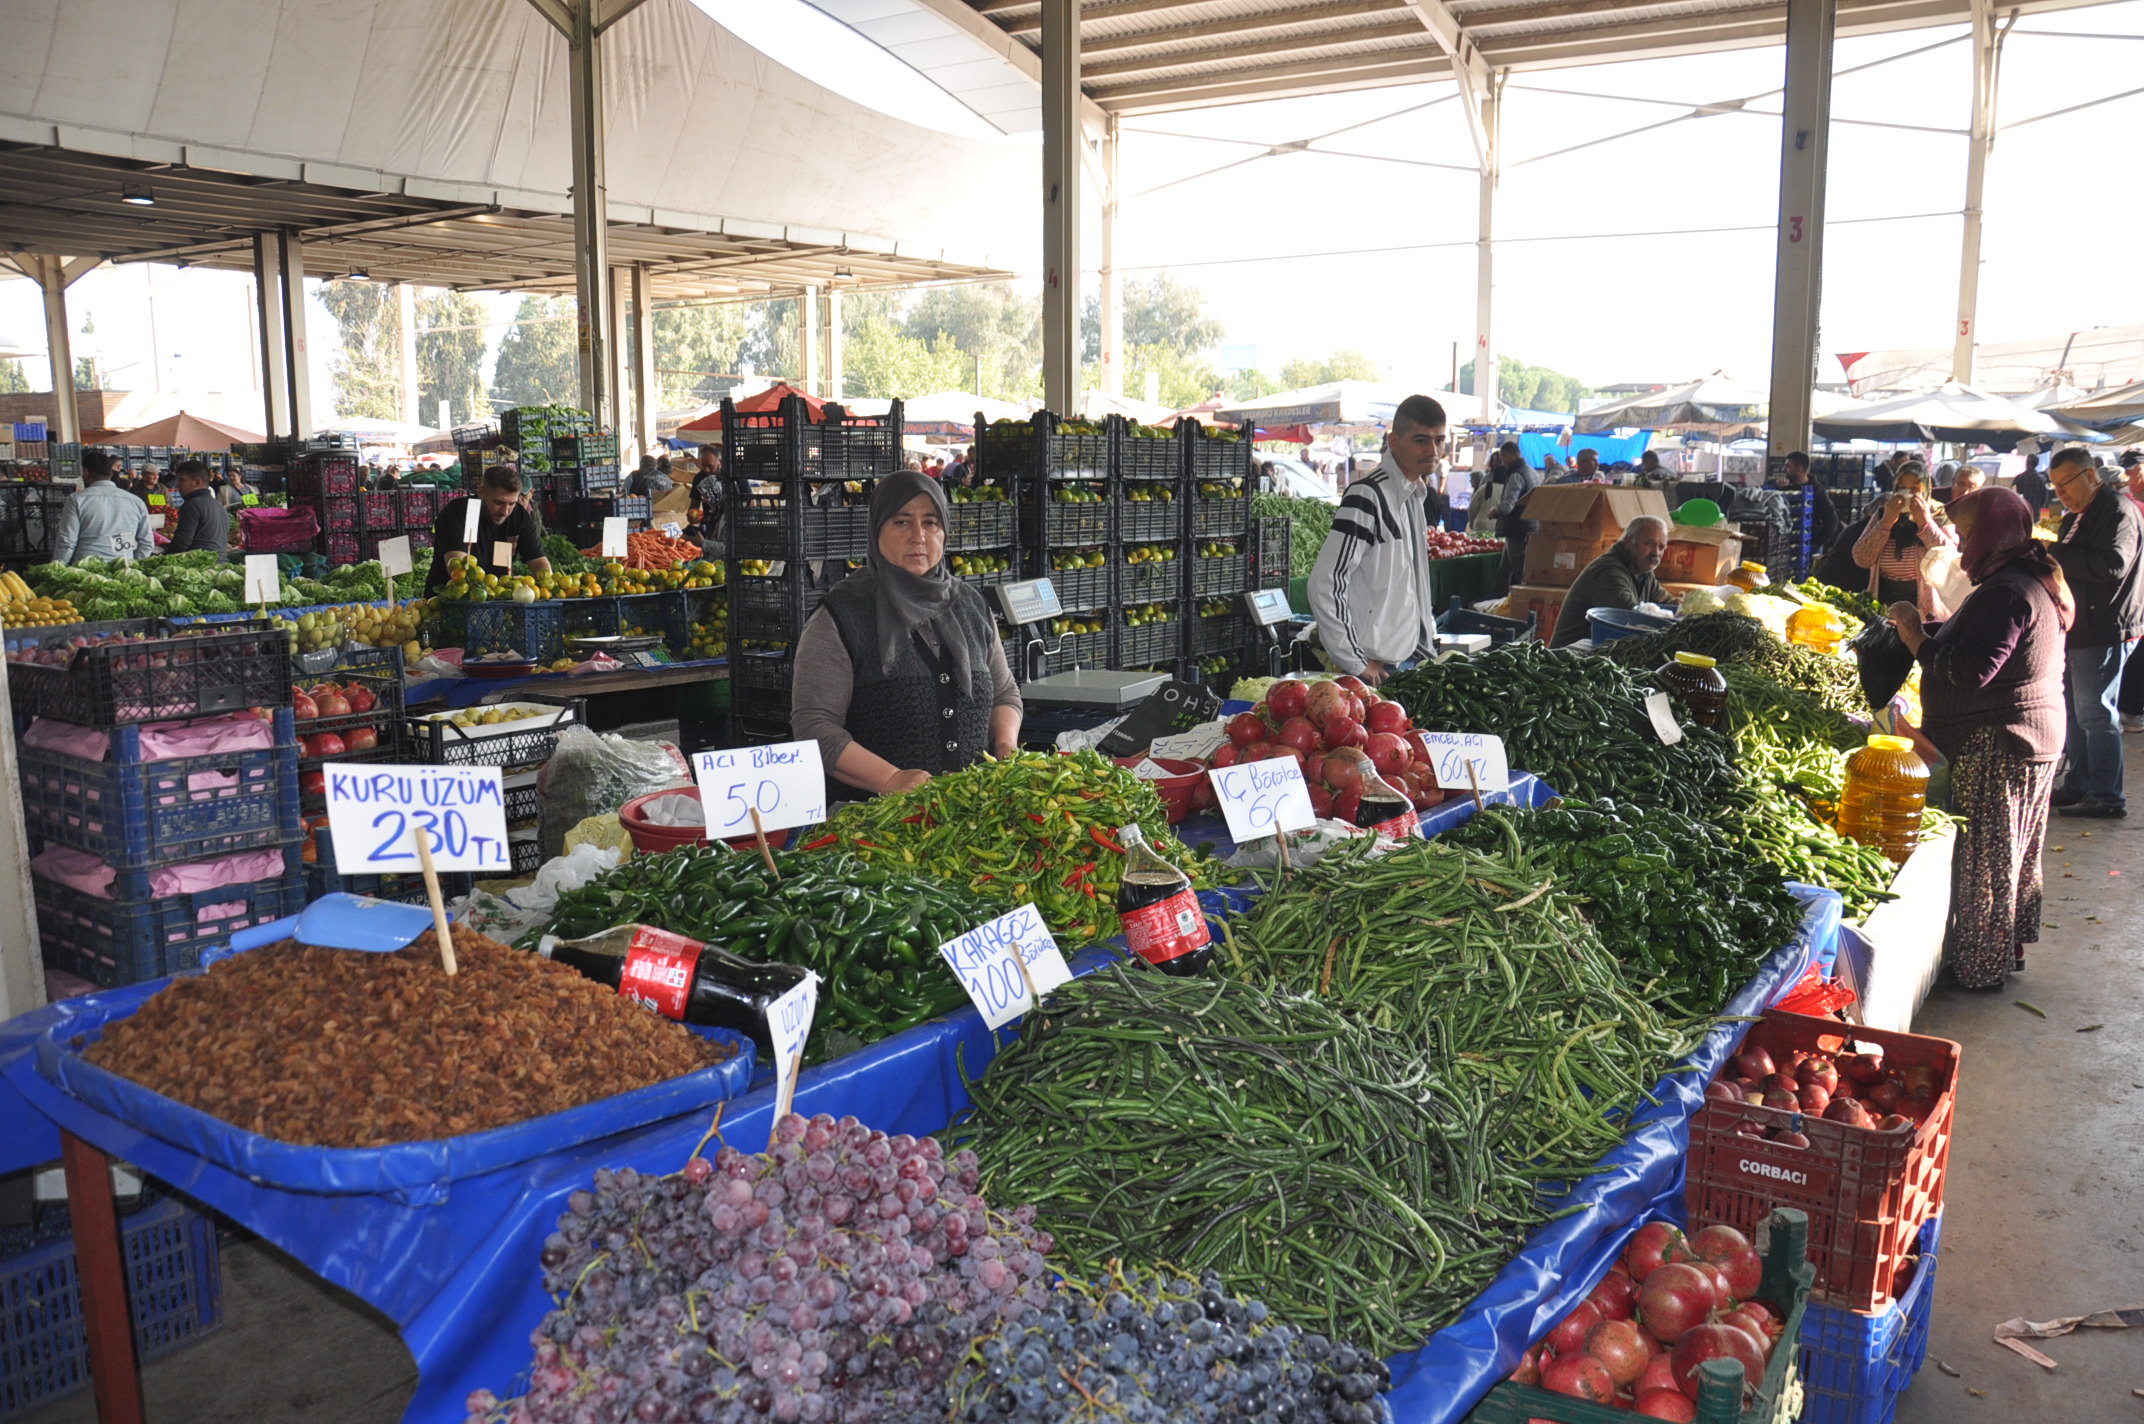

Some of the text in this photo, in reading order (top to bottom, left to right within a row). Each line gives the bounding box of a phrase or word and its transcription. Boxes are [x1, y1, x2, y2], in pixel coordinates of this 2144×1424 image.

[1789, 215, 1803, 243] 3
[1960, 320, 1969, 336] 3
[703, 754, 735, 770] ACI
[332, 769, 502, 806] KURU ÜZÜM
[367, 809, 507, 866] 230 TL
[943, 910, 1037, 982] KARAGÖZ
[971, 957, 1024, 1017] 100
[780, 988, 809, 1034] ÜZÜM
[1739, 1159, 1807, 1186] ÇORBACI
